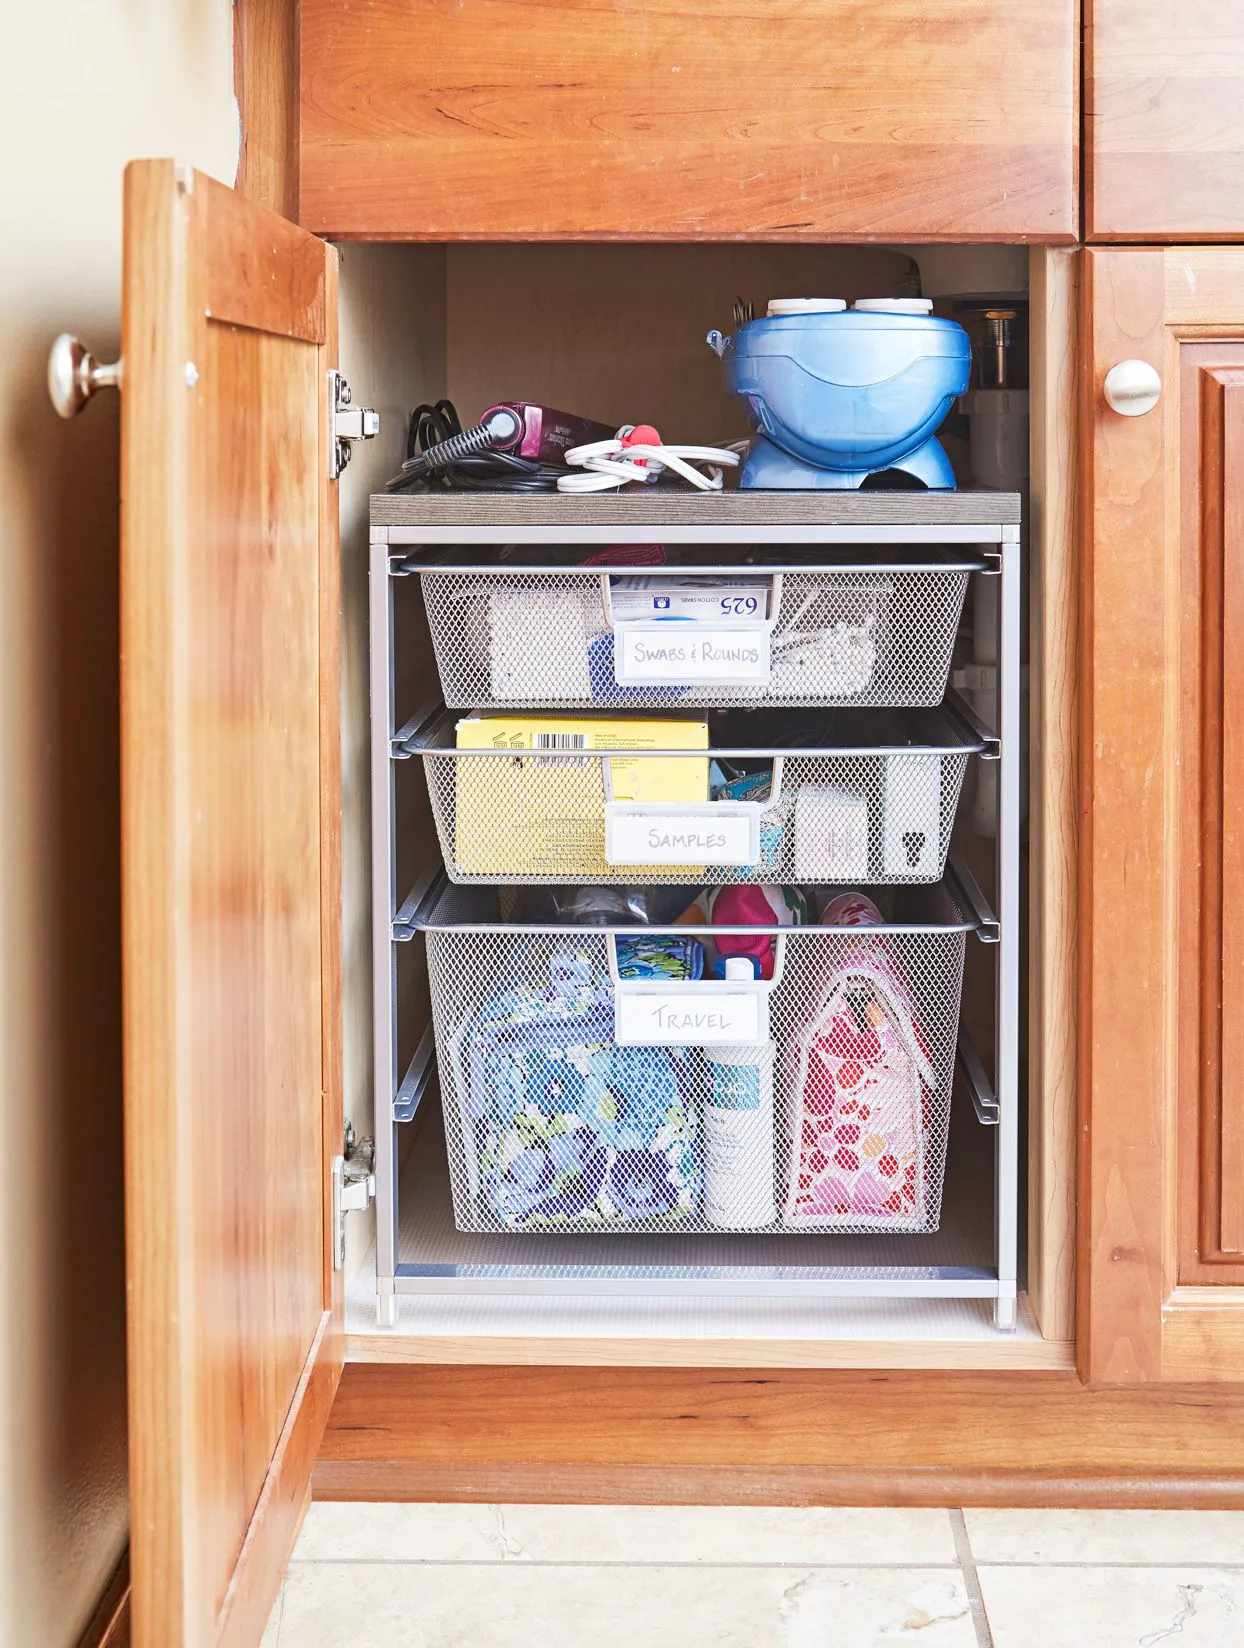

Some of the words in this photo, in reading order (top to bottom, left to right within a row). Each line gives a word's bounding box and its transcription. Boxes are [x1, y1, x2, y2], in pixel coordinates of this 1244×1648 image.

[720, 597, 758, 615] 625
[634, 642, 686, 662] SWABS
[702, 641, 760, 663] ROUNDS
[648, 828, 727, 848] SAMPLES
[651, 1003, 733, 1030] TRAVEL
